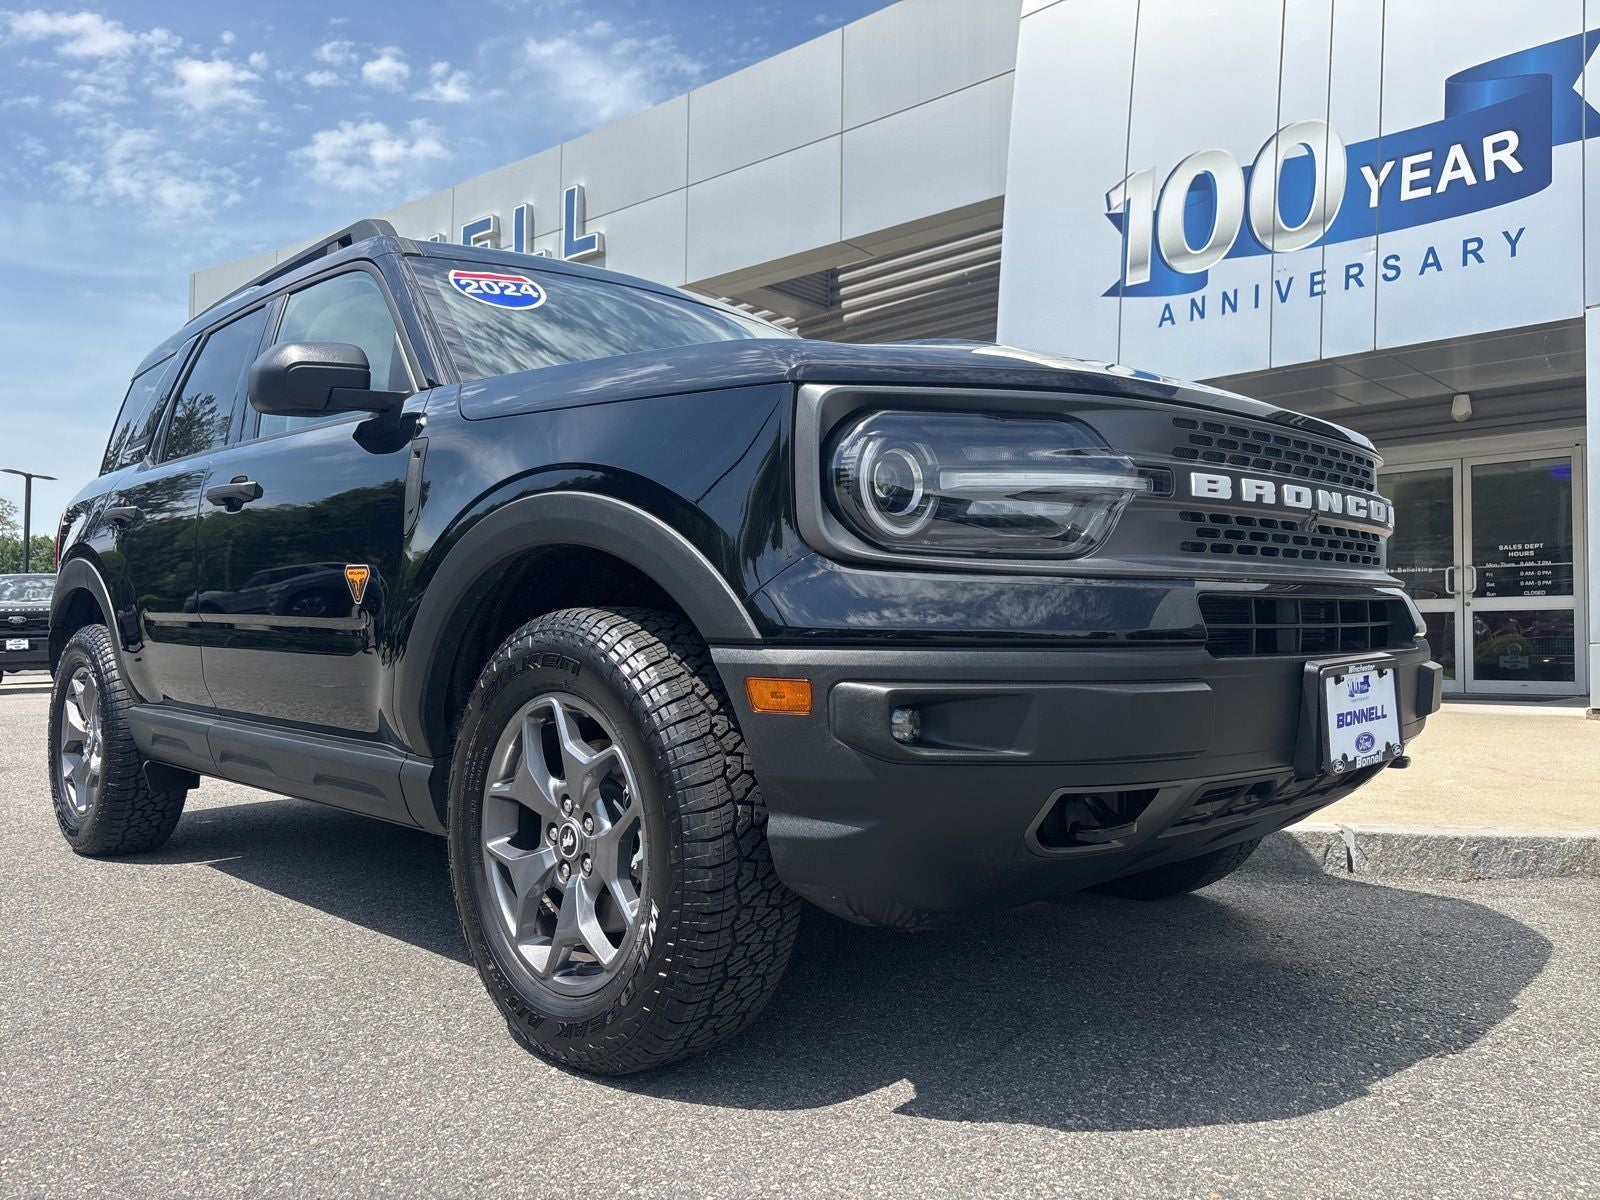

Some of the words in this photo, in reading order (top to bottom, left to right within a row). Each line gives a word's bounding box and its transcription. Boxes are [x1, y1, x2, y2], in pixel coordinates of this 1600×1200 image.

[1105, 119, 1347, 286] 100
[1360, 129, 1523, 208] YEAR
[460, 279, 539, 298] 2024
[1158, 227, 1526, 328] ANNIVERSARY
[1190, 472, 1386, 523] BRONCO
[1336, 705, 1387, 729] BONNELL
[1356, 750, 1383, 768] Bonnell
